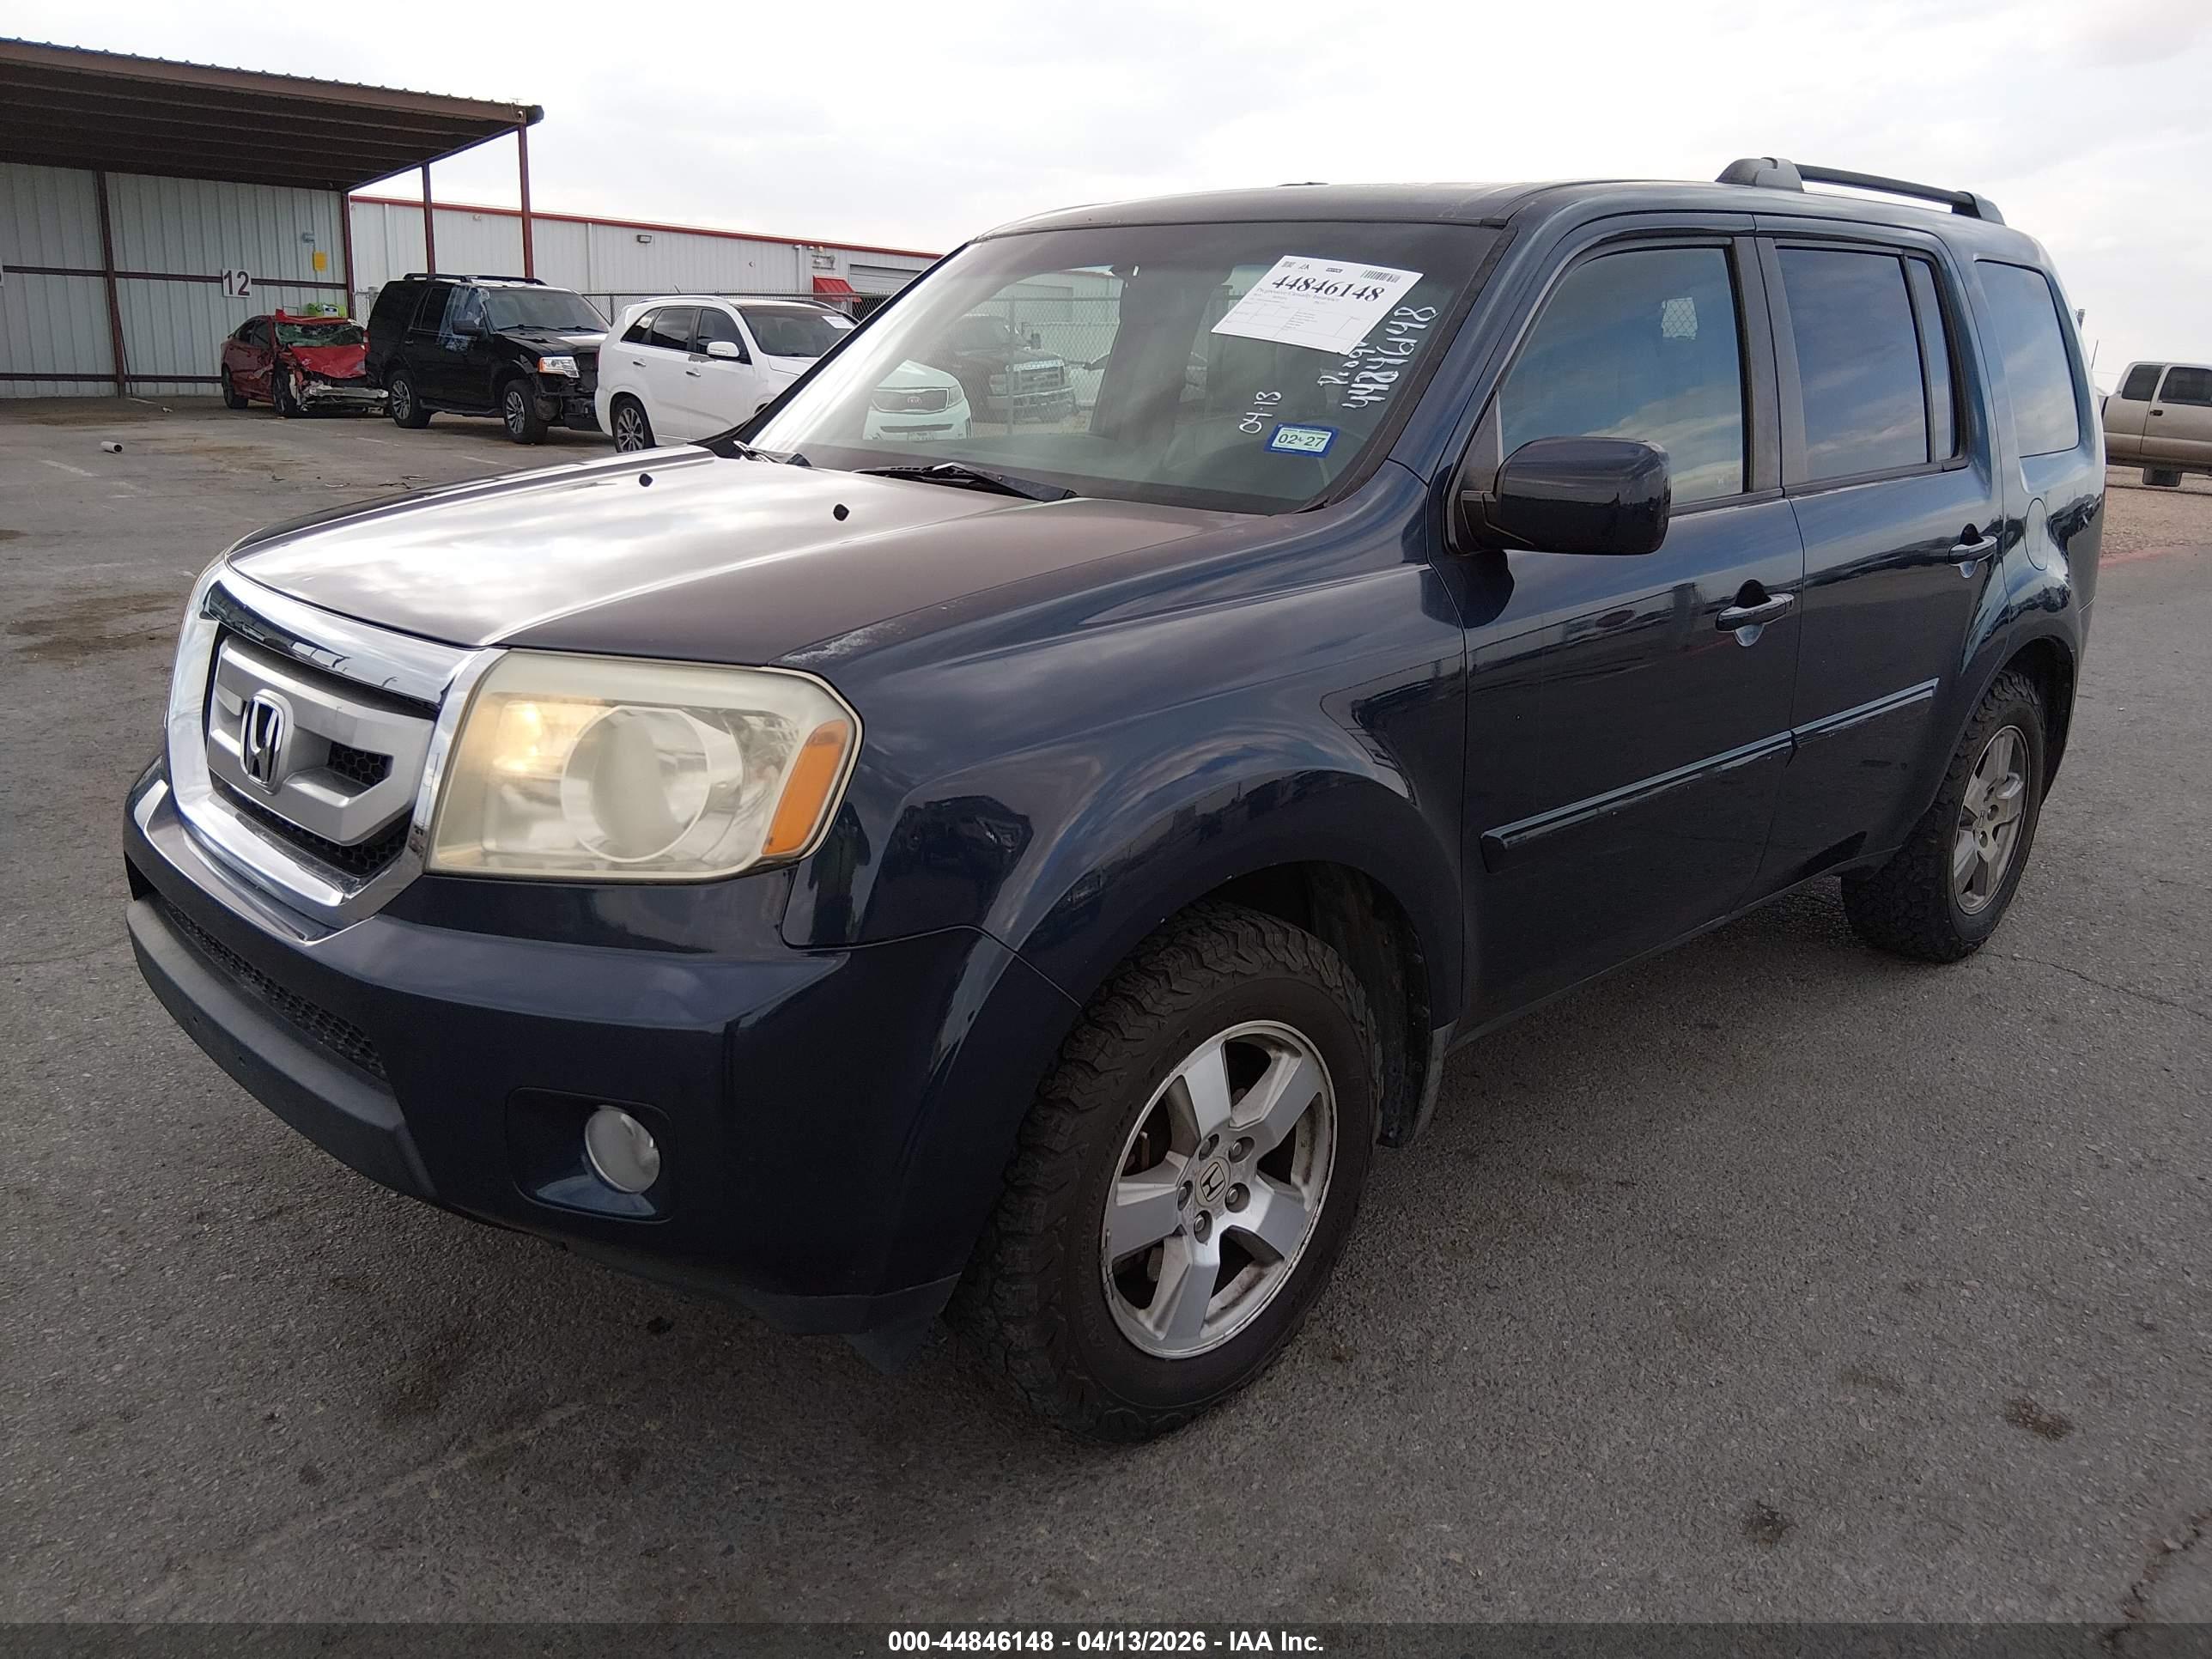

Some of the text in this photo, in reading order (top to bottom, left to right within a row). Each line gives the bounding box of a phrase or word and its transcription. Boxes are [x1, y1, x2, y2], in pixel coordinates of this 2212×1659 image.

[223, 270, 250, 295] 12
[1272, 275, 1385, 302] 44846148
[1341, 307, 1439, 409] 44846148
[1278, 434, 1326, 447] 02 27
